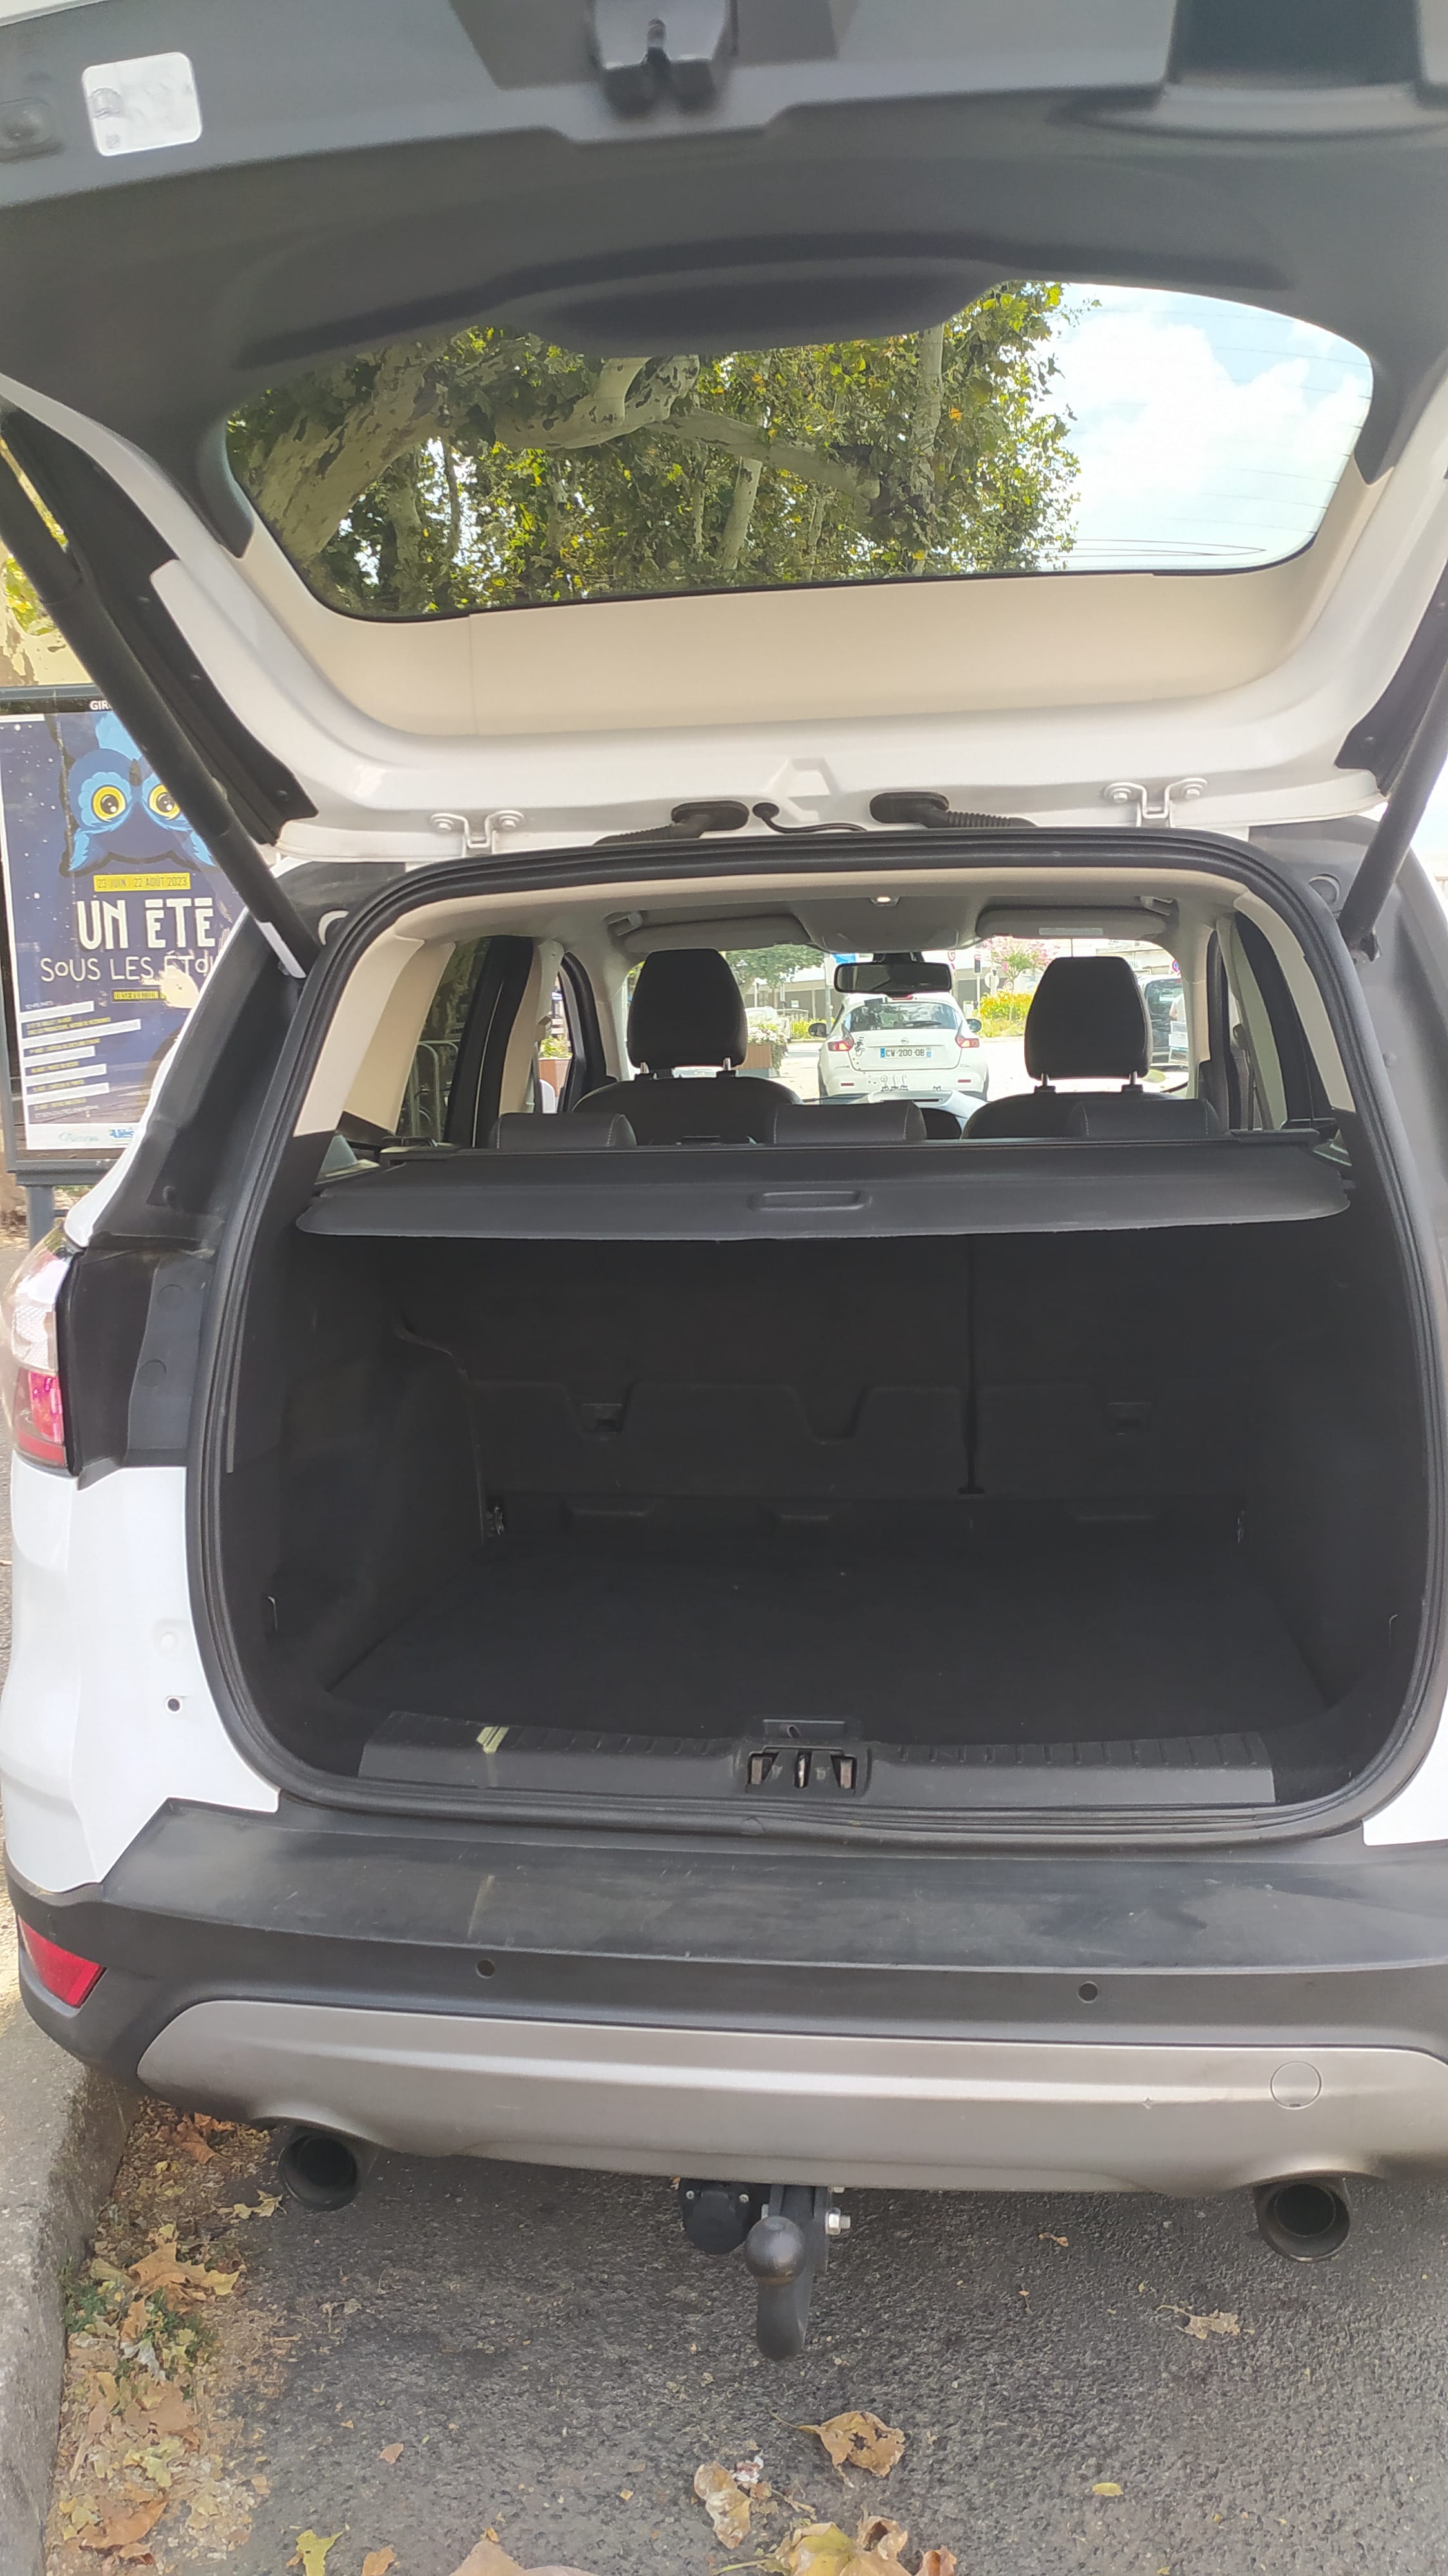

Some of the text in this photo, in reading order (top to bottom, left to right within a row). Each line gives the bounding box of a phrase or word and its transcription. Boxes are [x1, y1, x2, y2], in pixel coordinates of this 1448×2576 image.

[134, 878, 142, 887] 22
[167, 876, 187, 886] 2023
[76, 900, 129, 951] UN
[110, 956, 155, 980] LES
